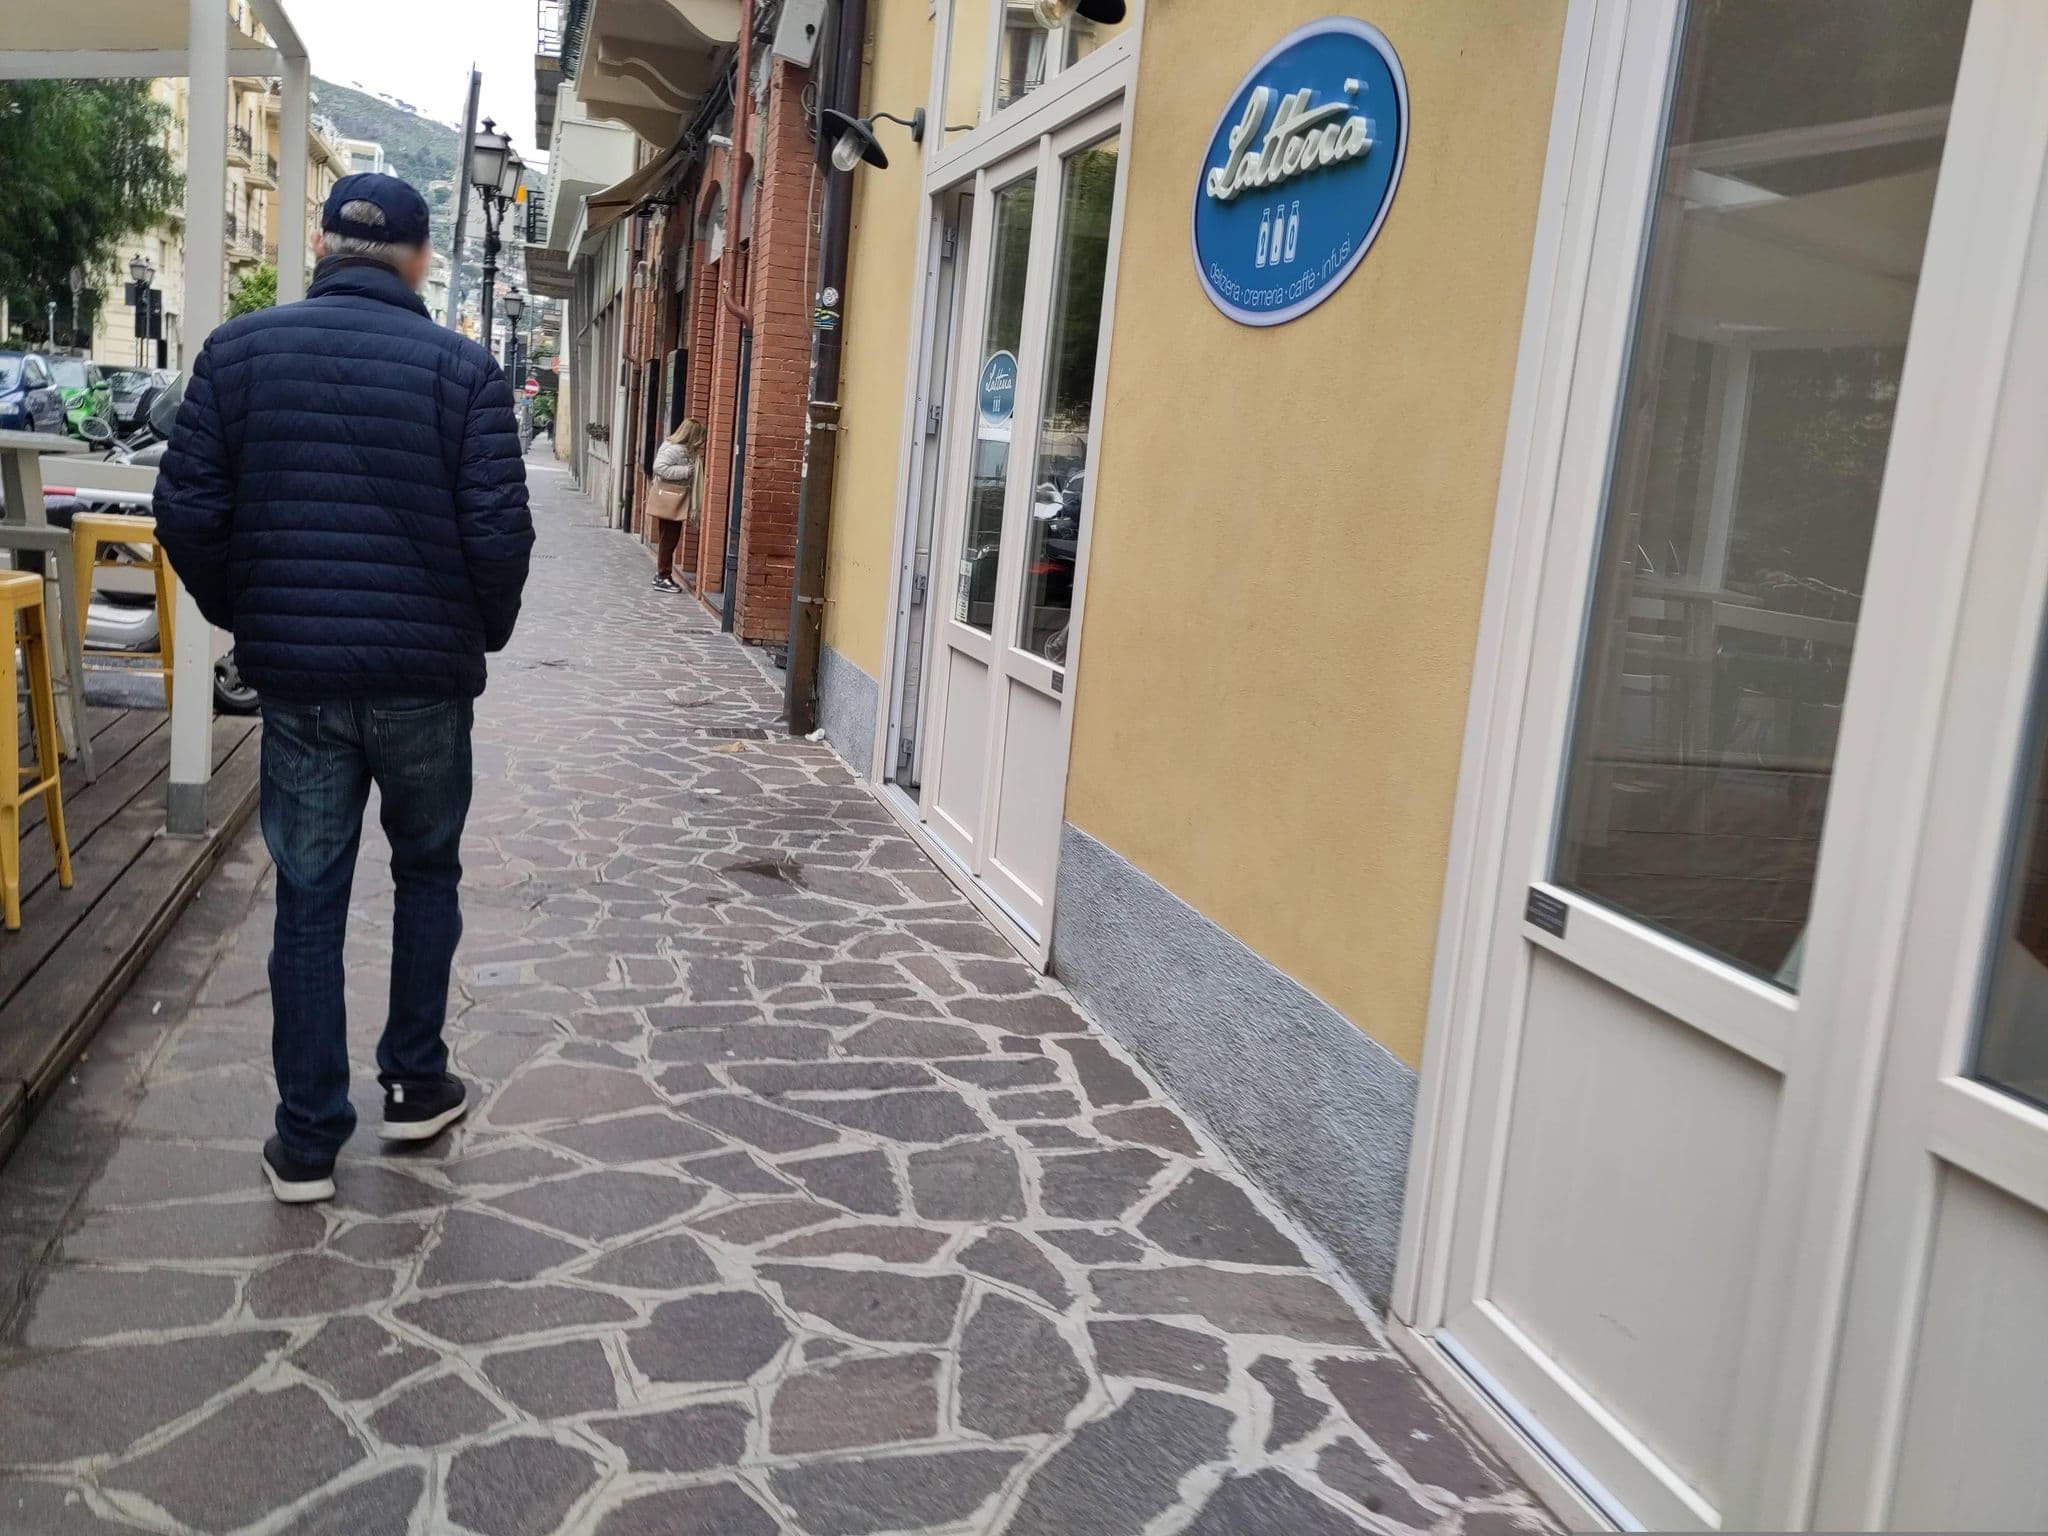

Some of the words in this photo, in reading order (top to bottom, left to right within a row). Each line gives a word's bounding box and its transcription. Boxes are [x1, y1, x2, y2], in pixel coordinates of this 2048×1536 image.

[1207, 78, 1372, 199] Latteria
[1244, 284, 1284, 306] cremeria
[1321, 232, 1351, 280] infusi
